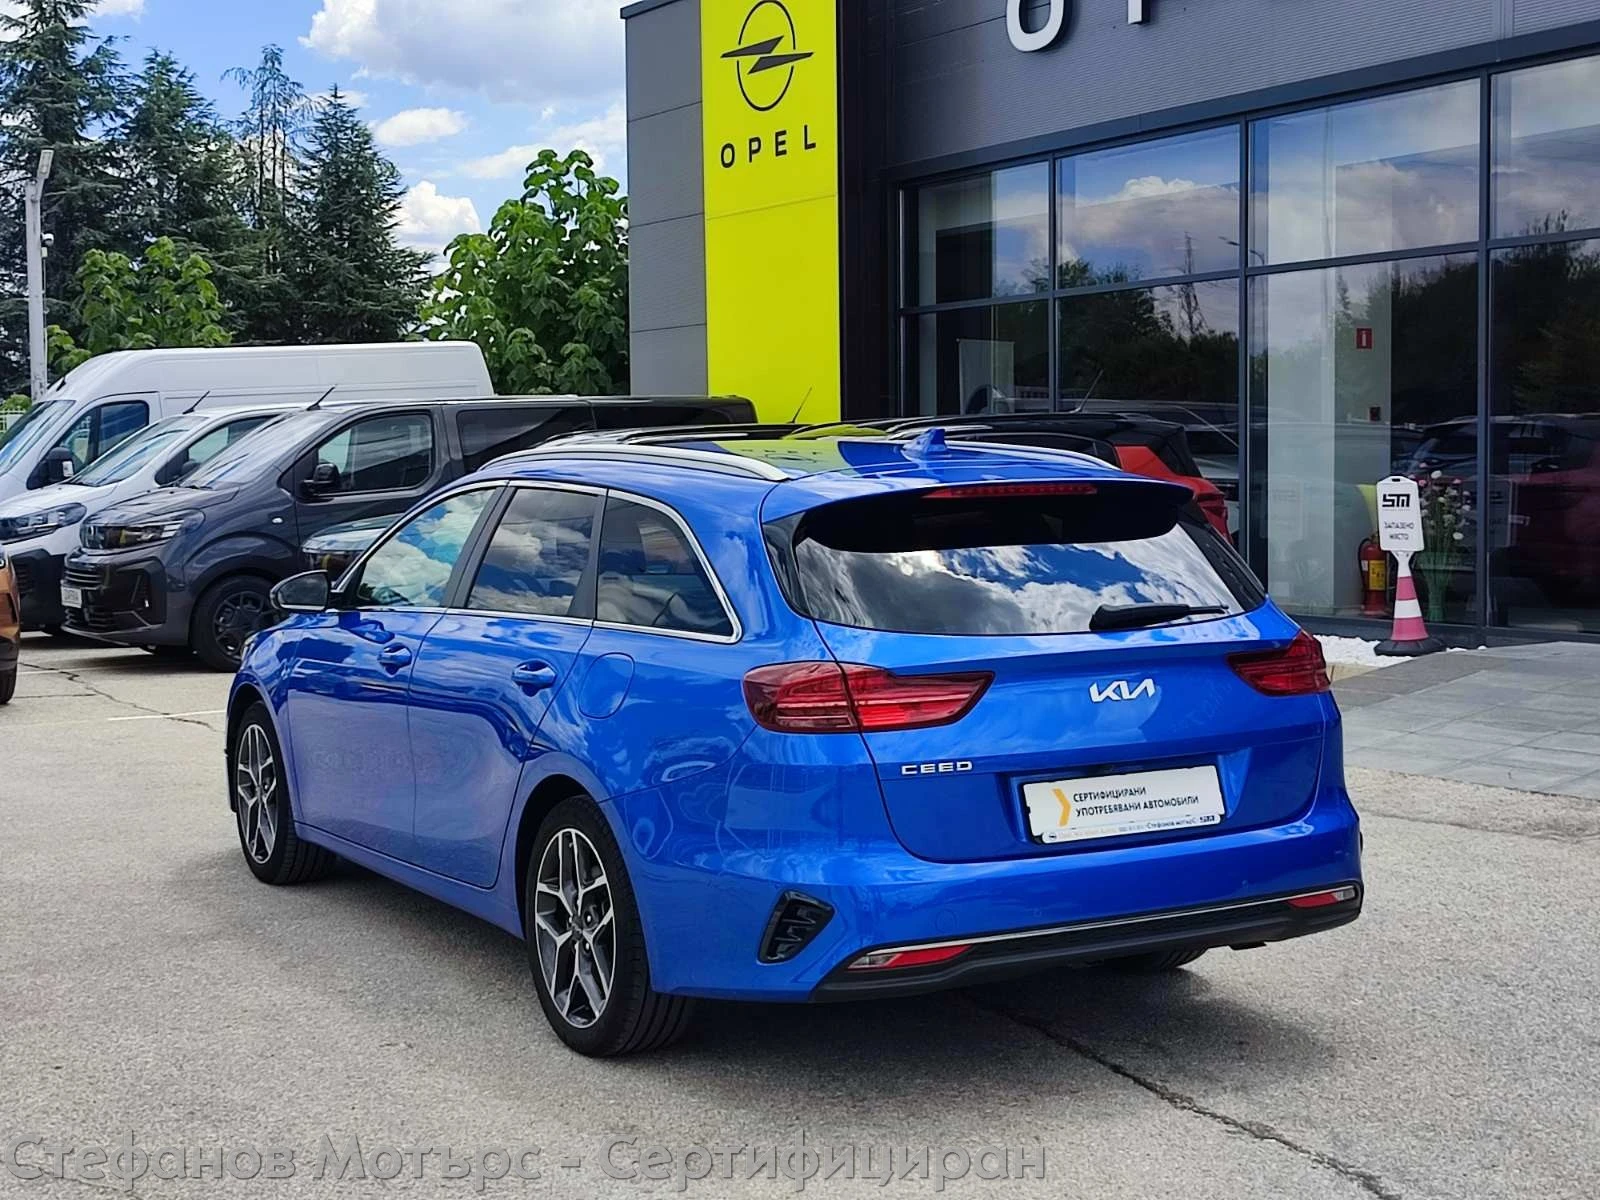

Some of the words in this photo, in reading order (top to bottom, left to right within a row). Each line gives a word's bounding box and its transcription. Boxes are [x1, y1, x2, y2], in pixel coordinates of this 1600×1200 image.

[720, 124, 817, 169] OPEL
[1089, 678, 1156, 704] KIA
[901, 760, 973, 776] CEED
[1073, 786, 1147, 803] СЕРТИФИЦИРАНИ
[1076, 801, 1142, 818] УПОТРЕБЯВАНИ
[1143, 795, 1200, 810] АВТОМОБИЛИ
